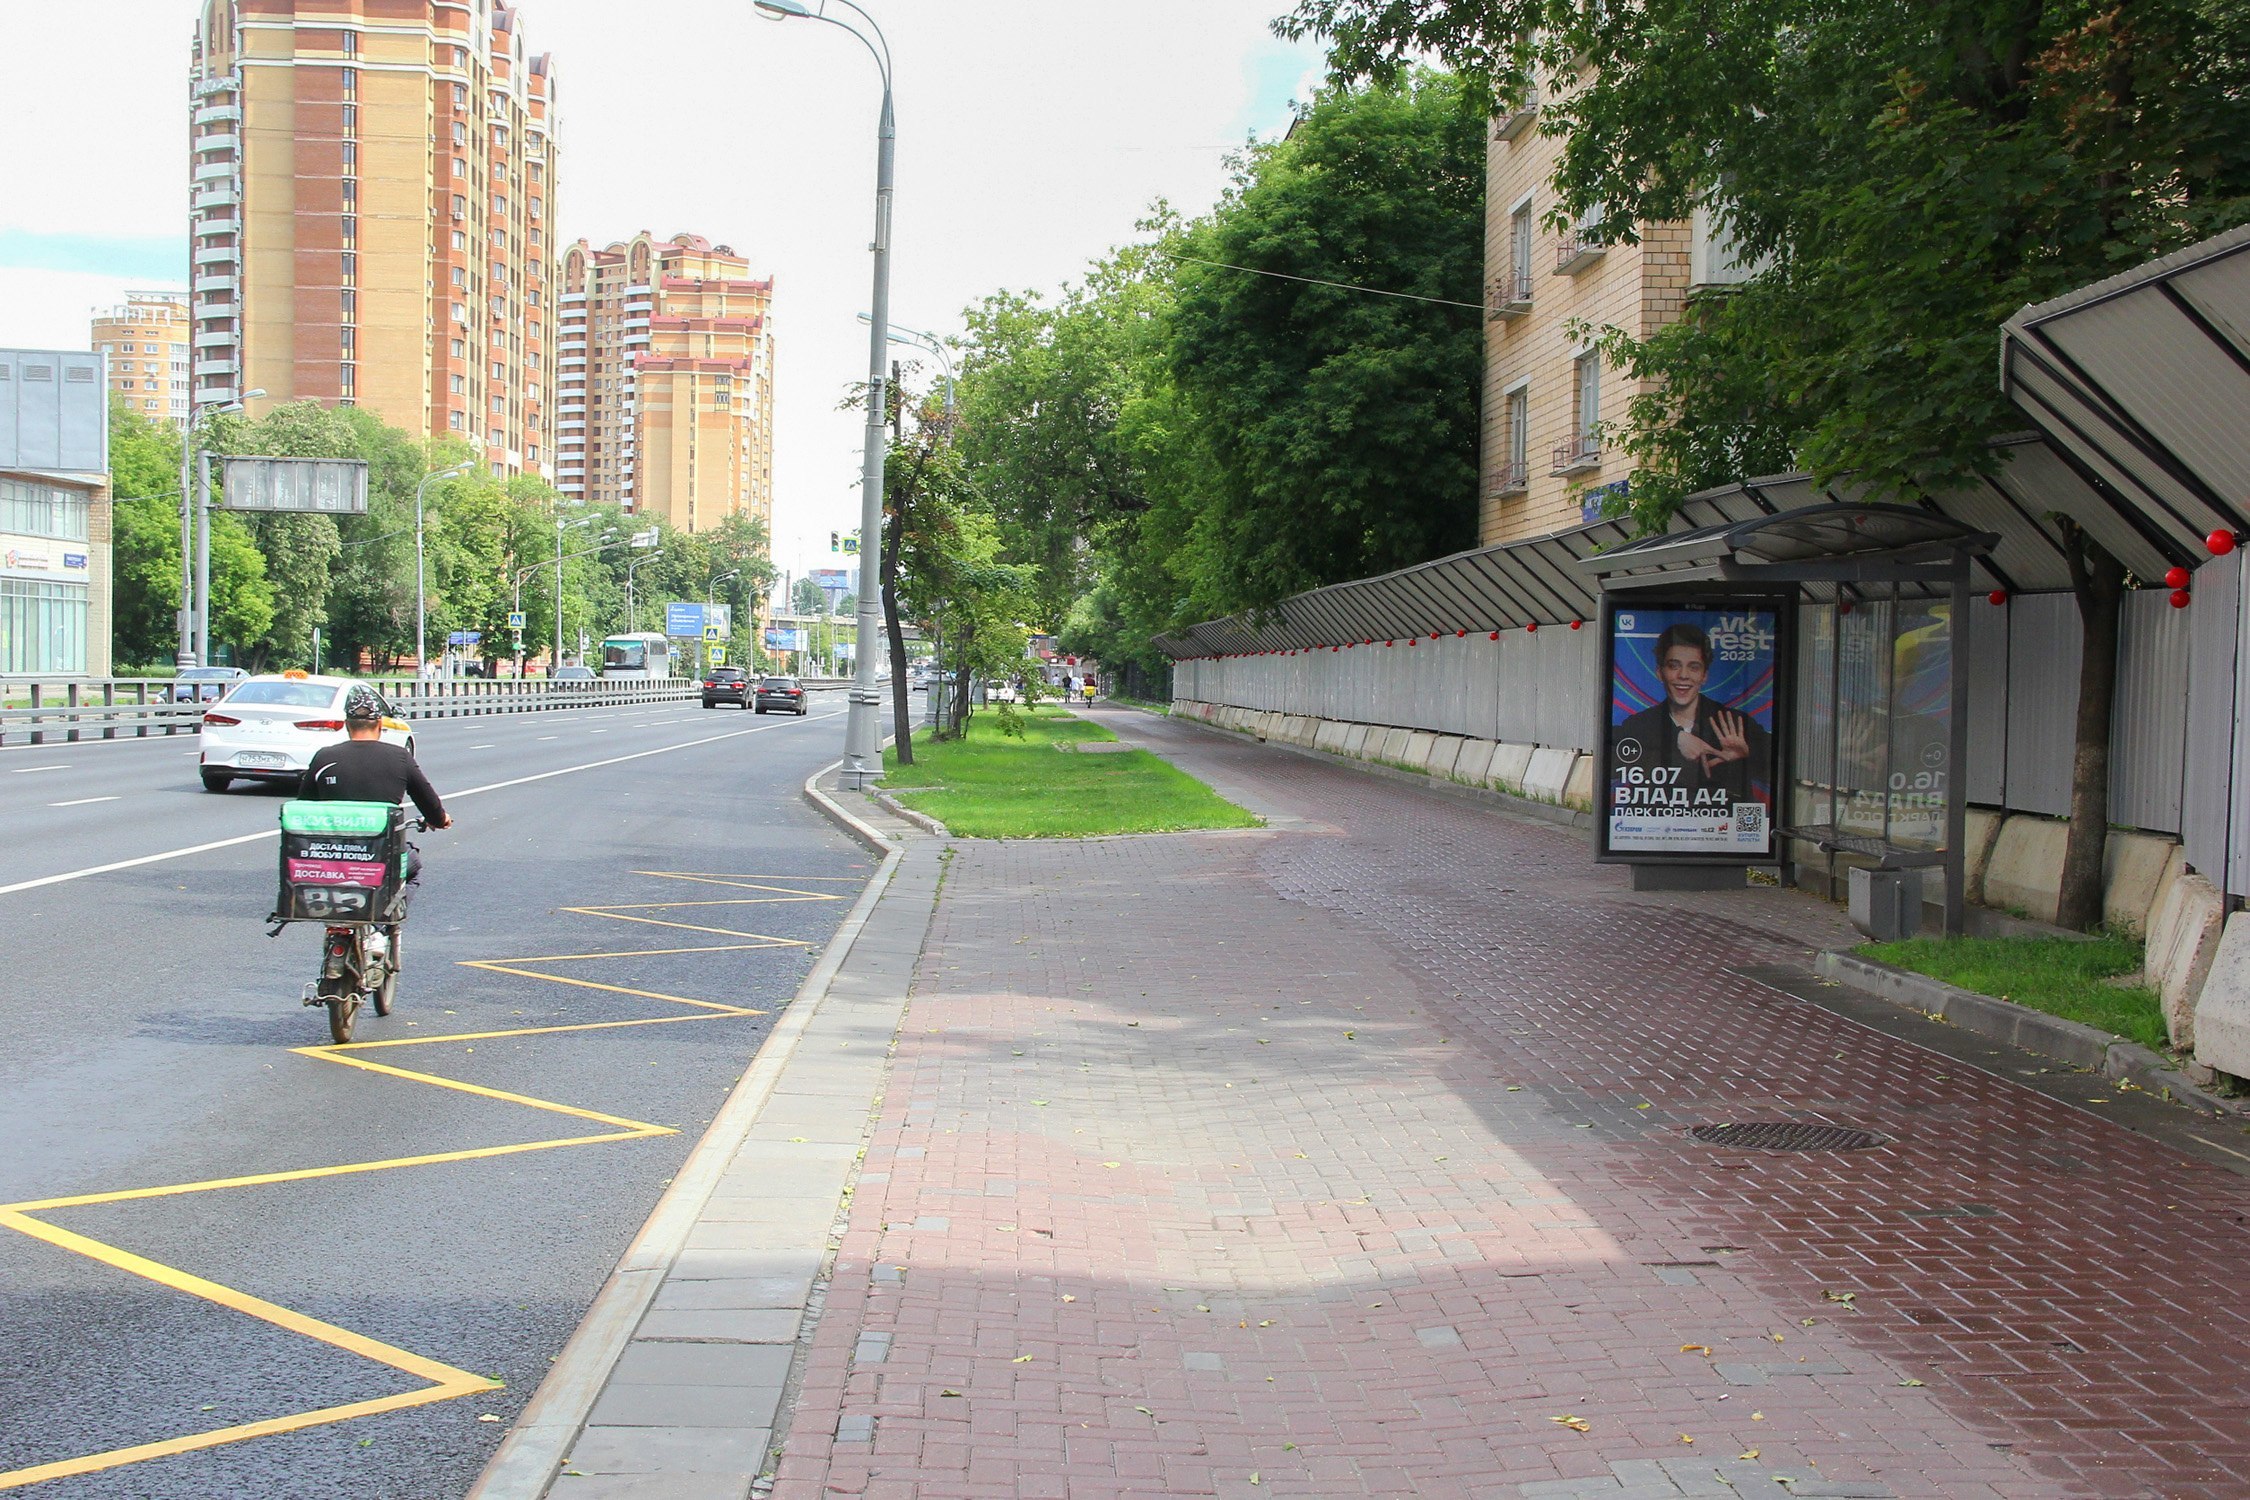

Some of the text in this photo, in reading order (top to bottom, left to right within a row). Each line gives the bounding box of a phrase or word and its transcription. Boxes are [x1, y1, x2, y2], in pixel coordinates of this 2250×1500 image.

[1720, 616, 1757, 633] VK
[1709, 627, 1771, 650] fest
[1720, 651, 1755, 661] 2023
[1622, 745, 1638, 756] 0+
[325, 776, 337, 785] TM
[1615, 766, 1682, 785] 16.07
[1615, 787, 1729, 808] ВЛАД А4
[1614, 807, 1729, 819] ПАРК ГОРЬКОГО
[291, 815, 377, 828] ВКУСВИЛЛ
[309, 843, 367, 853] ДОСТАВЛЯЕМ
[300, 850, 309, 858] В
[342, 852, 376, 862] ПОГОДУ
[294, 870, 346, 880] ДОСТАВКА
